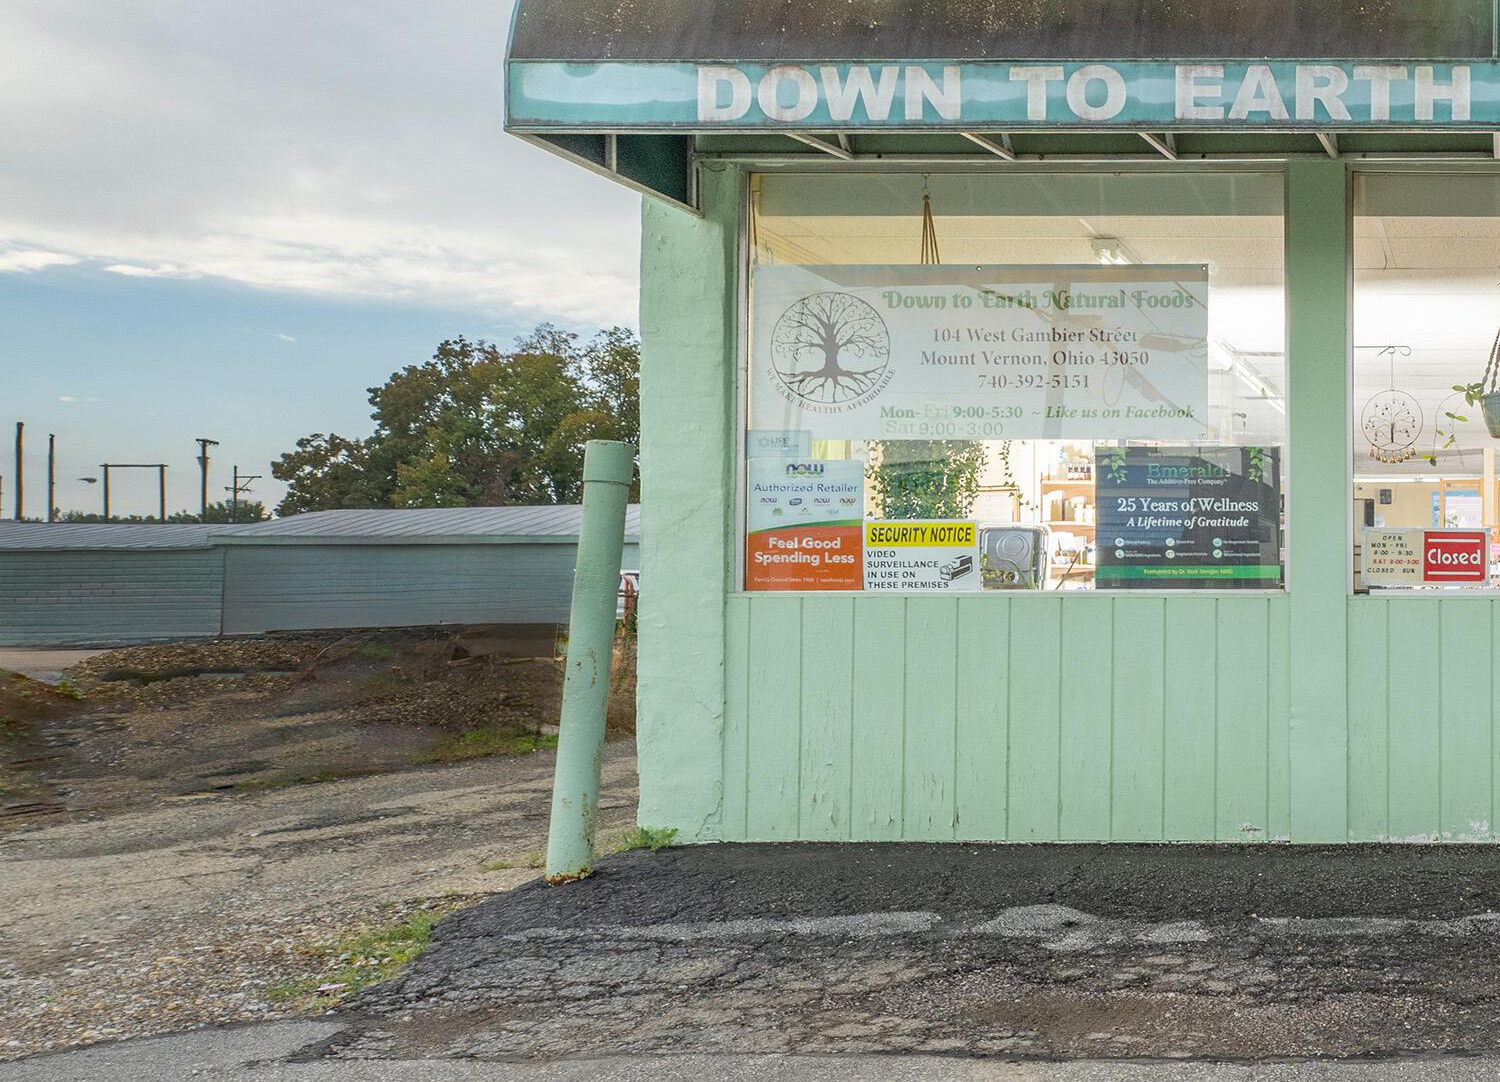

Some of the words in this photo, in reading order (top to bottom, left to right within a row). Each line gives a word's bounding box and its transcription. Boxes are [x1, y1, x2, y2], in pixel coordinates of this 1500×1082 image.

[697, 65, 961, 121] DOWN
[1009, 65, 1126, 120] TO
[1175, 65, 1471, 120] EARTH
[882, 291, 947, 310] Down
[952, 292, 973, 309] to
[978, 290, 1038, 310] Earth
[1042, 289, 1126, 310] Natural
[1131, 289, 1194, 309] Foods
[934, 328, 961, 342] 104
[966, 328, 1006, 342] West
[1011, 327, 1085, 342] Gambier
[1089, 327, 1138, 342] Street
[920, 351, 976, 366] Mount
[982, 351, 1048, 367] Vernon,
[1053, 351, 1095, 366] Ohio
[1099, 351, 1149, 366] 43050
[978, 374, 1089, 388] 740-392-5151
[924, 404, 949, 418] Fri
[953, 406, 1023, 418] 9:00-5:30
[1045, 406, 1081, 418] Like
[1082, 409, 1098, 418] us
[1102, 409, 1120, 418] on
[1125, 405, 1195, 418] Facebook
[885, 420, 918, 434] Sat
[1146, 463, 1224, 477] Emerald
[753, 483, 813, 492] Authorized
[817, 483, 858, 492] Retailer
[1117, 498, 1136, 512] 25
[1139, 498, 1178, 512] Years
[1181, 497, 1198, 512] of
[1198, 497, 1259, 512] Wellness
[1127, 517, 1136, 526] A
[1137, 517, 1183, 529] Lifetime
[1184, 517, 1198, 529] of
[1197, 517, 1249, 527] Gratitude
[870, 527, 927, 542] SECURITY
[930, 527, 972, 542] NOTICE
[768, 537, 798, 548] Feel
[802, 537, 841, 549] Good
[754, 551, 820, 566] Spending
[825, 552, 855, 564] Less
[1427, 548, 1481, 565] Closed
[868, 581, 899, 589] THESE
[902, 581, 949, 589] PREMISES
